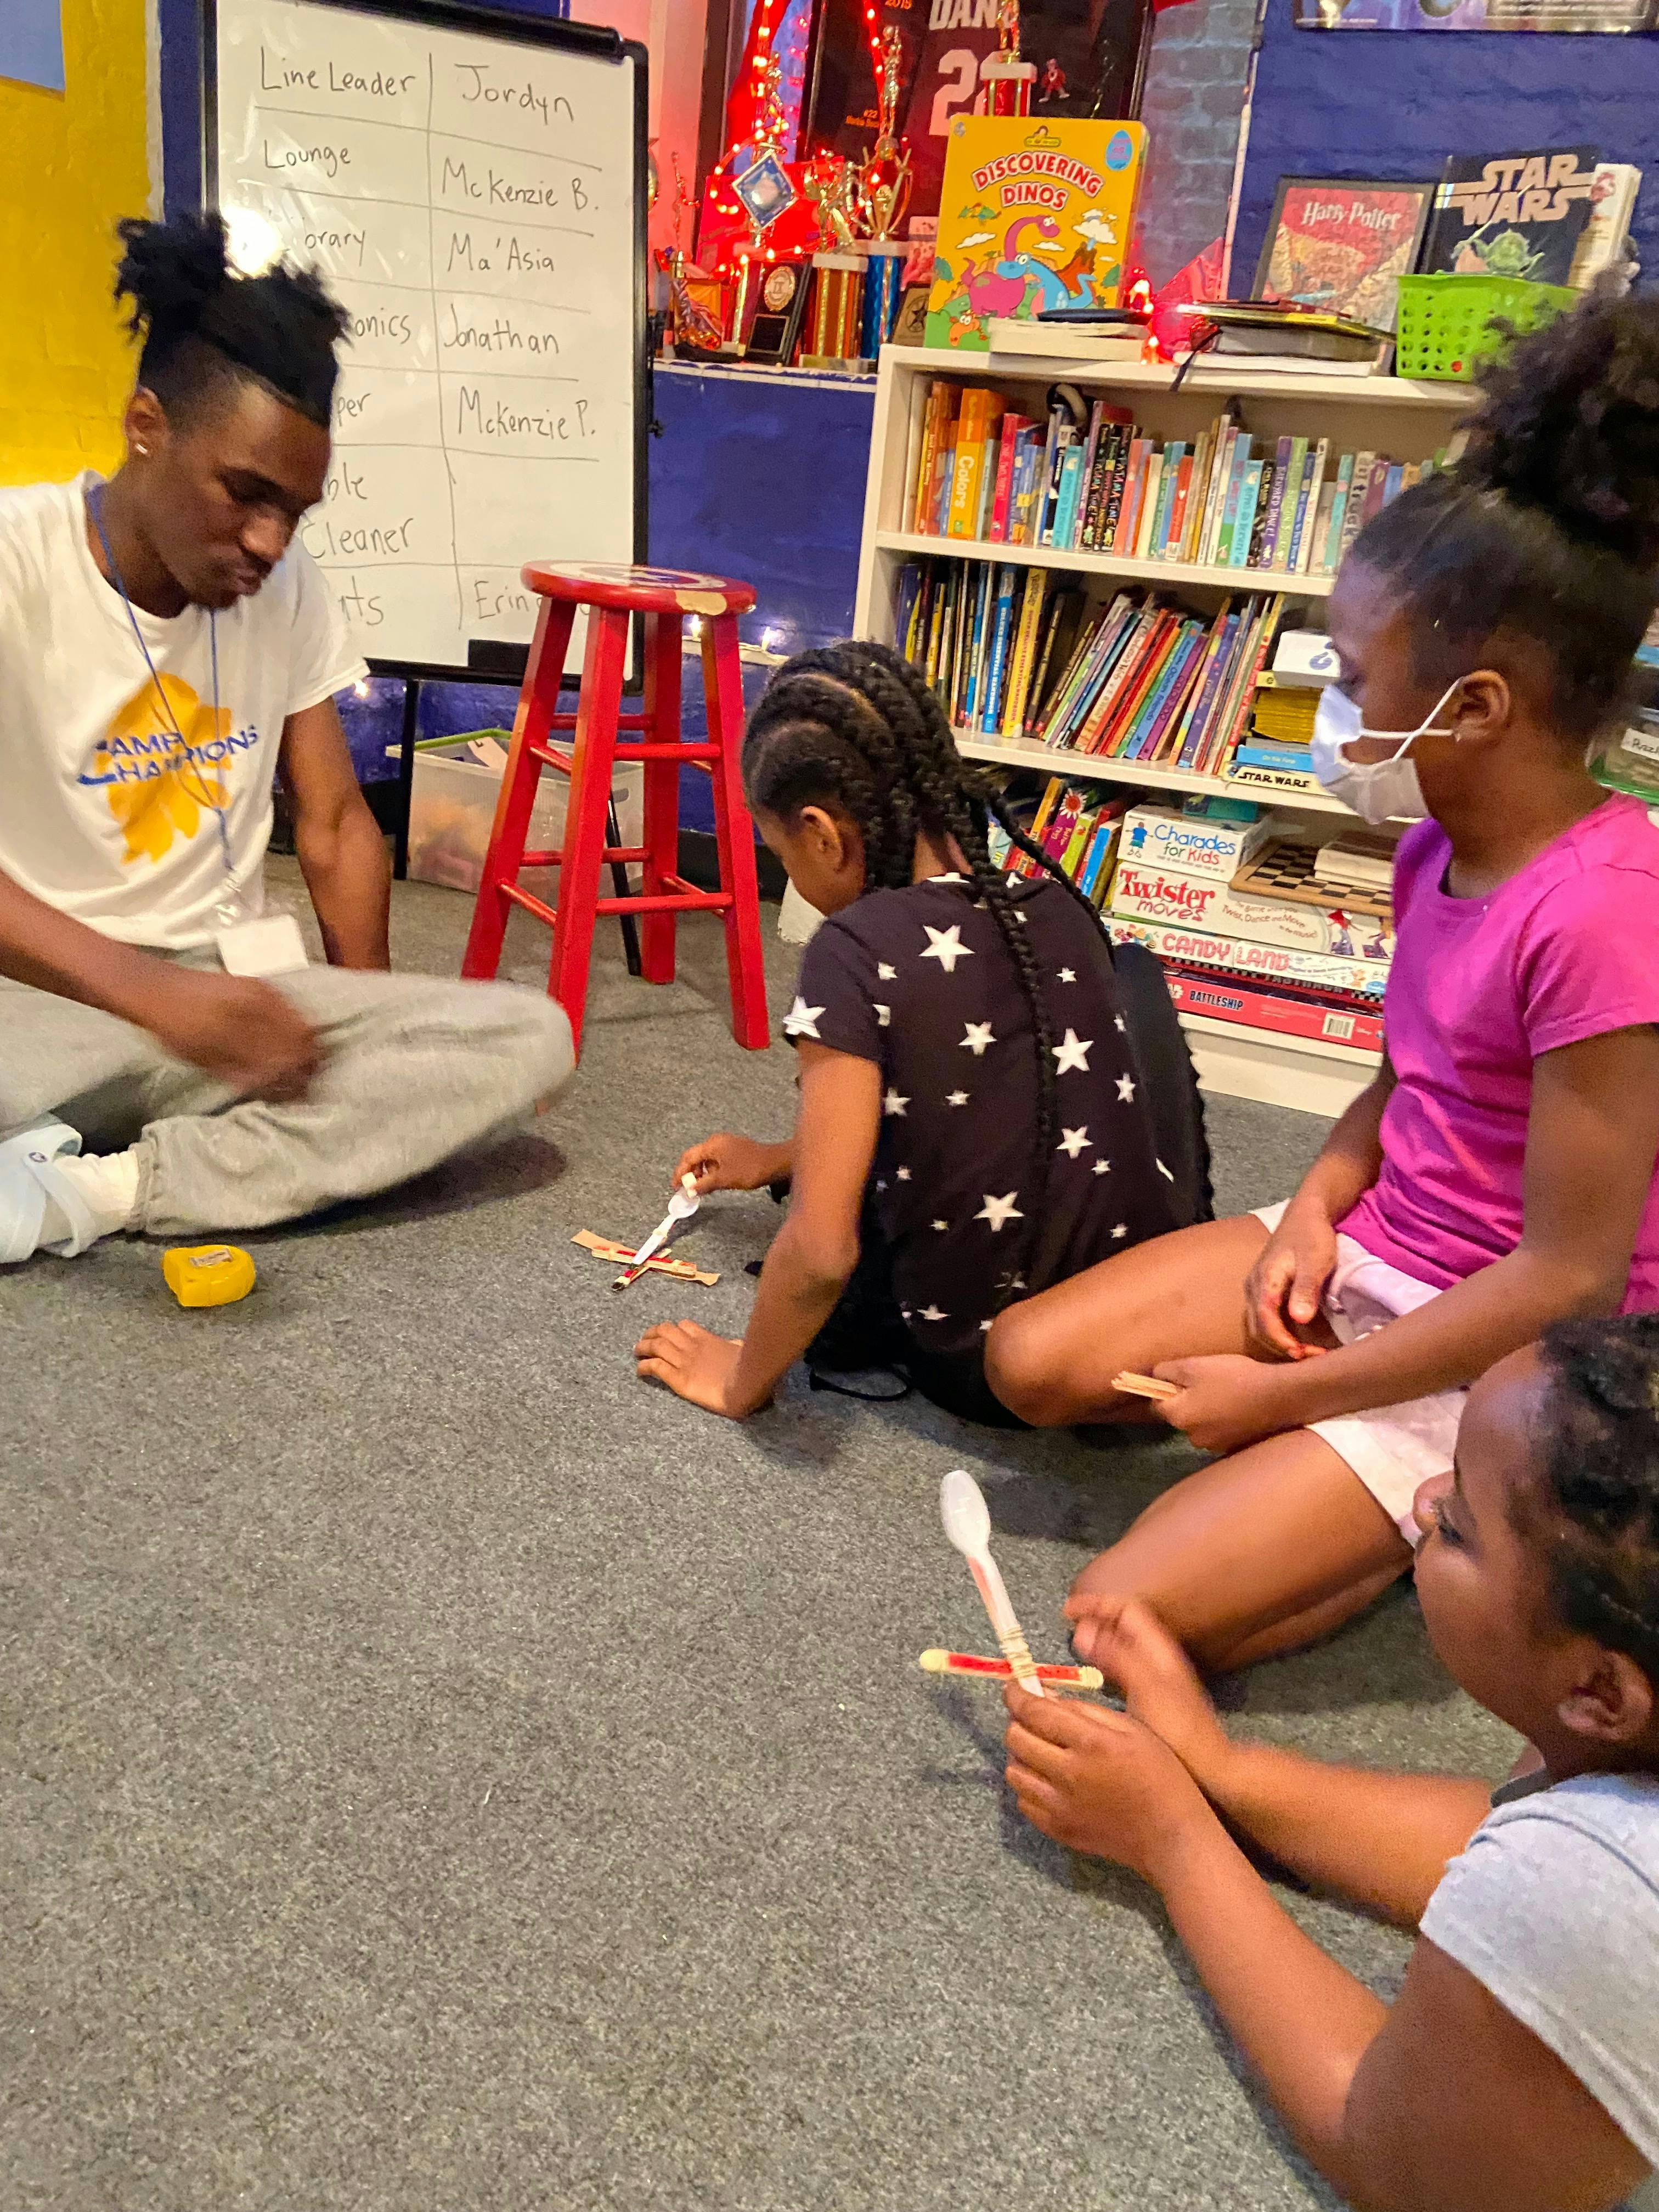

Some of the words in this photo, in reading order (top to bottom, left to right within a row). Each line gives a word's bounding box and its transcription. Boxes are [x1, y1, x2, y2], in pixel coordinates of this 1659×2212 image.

[261, 46, 318, 92] Line
[329, 61, 416, 97] Leader
[455, 64, 574, 126] Jordyn
[264, 139, 352, 178] Lounge
[972, 151, 1103, 198] DISCOVERING
[1457, 154, 1588, 193] STAR
[572, 178, 600, 211] B.
[1001, 182, 1068, 211] DINOS
[1454, 187, 1583, 226] WARS
[1301, 201, 1345, 226] Harry
[1348, 201, 1402, 229] Potter
[447, 232, 555, 273] Ma'Asia
[443, 304, 560, 356] Jonathan
[458, 386, 569, 440] McKenzie
[576, 399, 595, 436] P.
[955, 455, 974, 509] Colors
[301, 517, 414, 558] Cleaner
[474, 580, 530, 619] Erin
[1238, 772, 1273, 783] STAR
[1274, 776, 1311, 788] WARS
[1154, 825, 1236, 855] Charades
[1164, 842, 1186, 857] for
[1187, 847, 1220, 865] Kids
[1119, 868, 1216, 910] Twister
[1136, 899, 1205, 922] moves
[1162, 933, 1231, 961] CANDY
[1235, 946, 1289, 972] LAND
[1189, 990, 1244, 1011] BATTLESHIP
